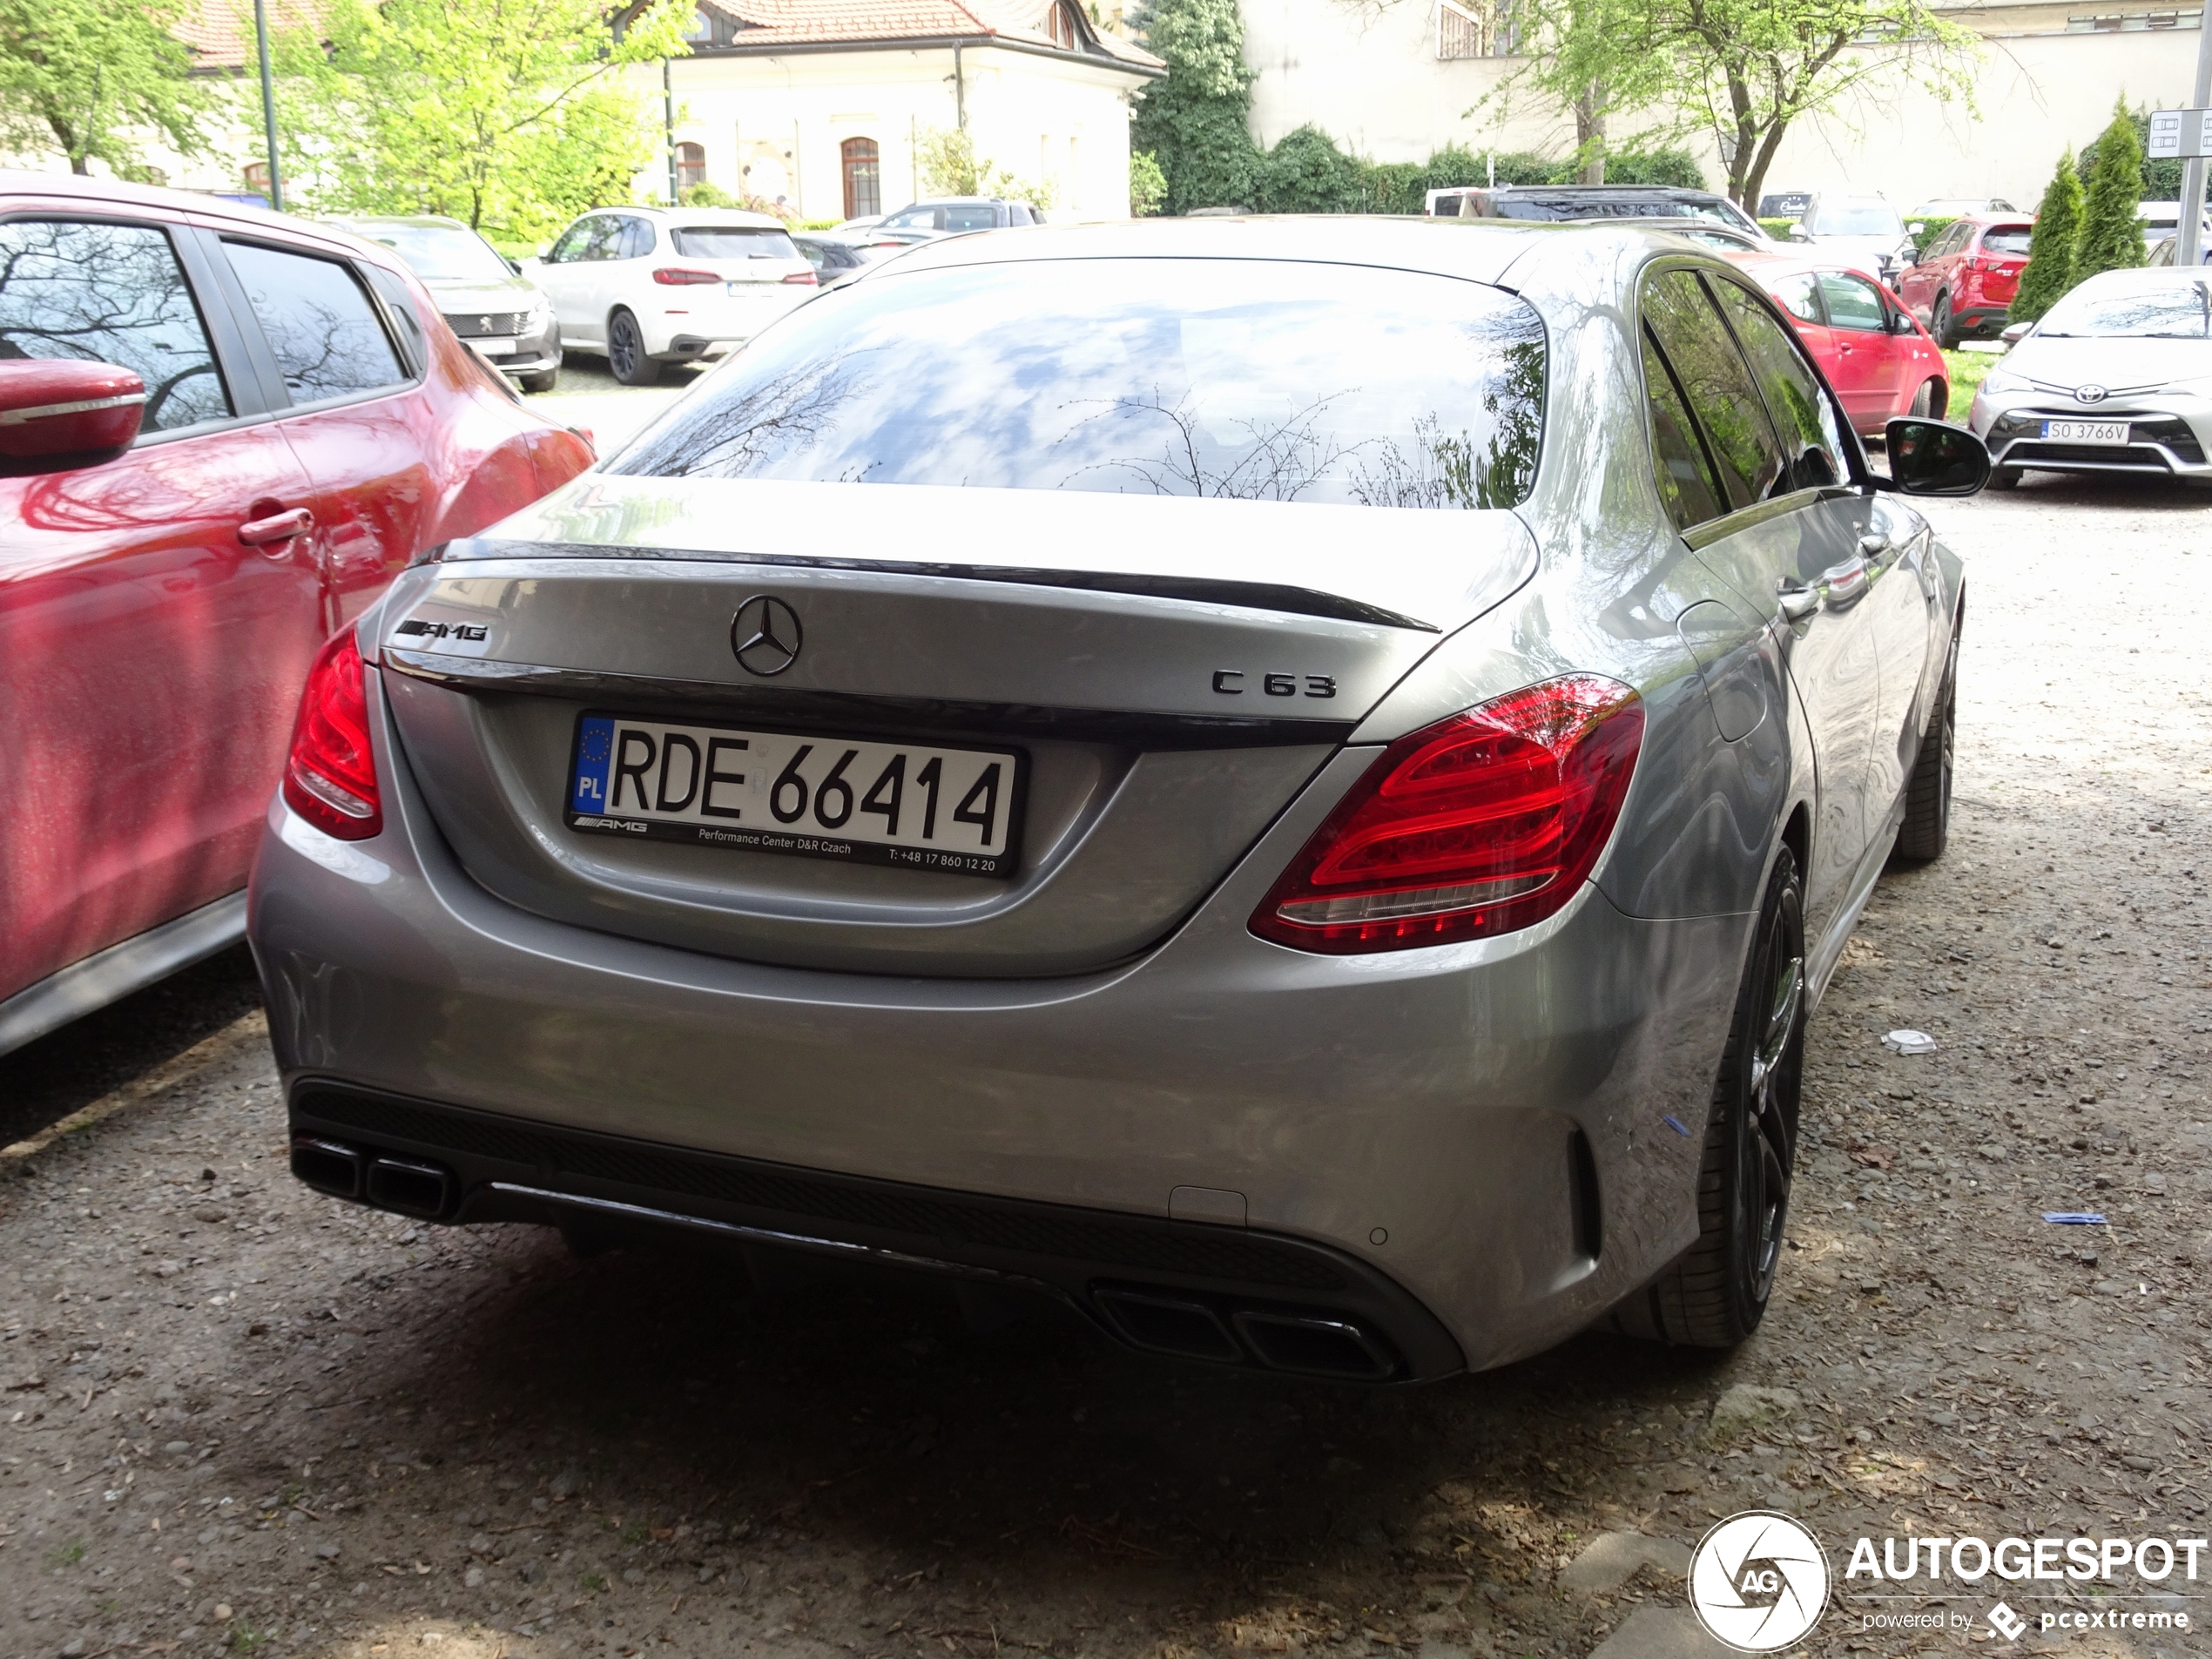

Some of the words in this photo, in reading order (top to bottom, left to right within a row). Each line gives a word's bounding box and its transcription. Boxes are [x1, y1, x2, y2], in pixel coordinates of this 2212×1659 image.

[2052, 423, 2071, 438] SO
[2077, 424, 2125, 440] 3766V
[421, 623, 488, 641] AMG
[1212, 669, 1244, 694] C
[1264, 671, 1337, 698] 63
[578, 777, 602, 799] PL
[611, 729, 750, 819] RDE
[769, 745, 1001, 846] 66414
[596, 819, 648, 833] AMG
[698, 828, 759, 846] Performance
[762, 835, 794, 848] Center
[797, 839, 819, 851] D&R
[821, 841, 851, 854] Czach
[889, 849, 898, 860] T:
[900, 852, 921, 863] +48
[926, 853, 938, 864] 17
[941, 855, 961, 867] 860
[966, 859, 978, 869] 12
[981, 860, 995, 872] 20
